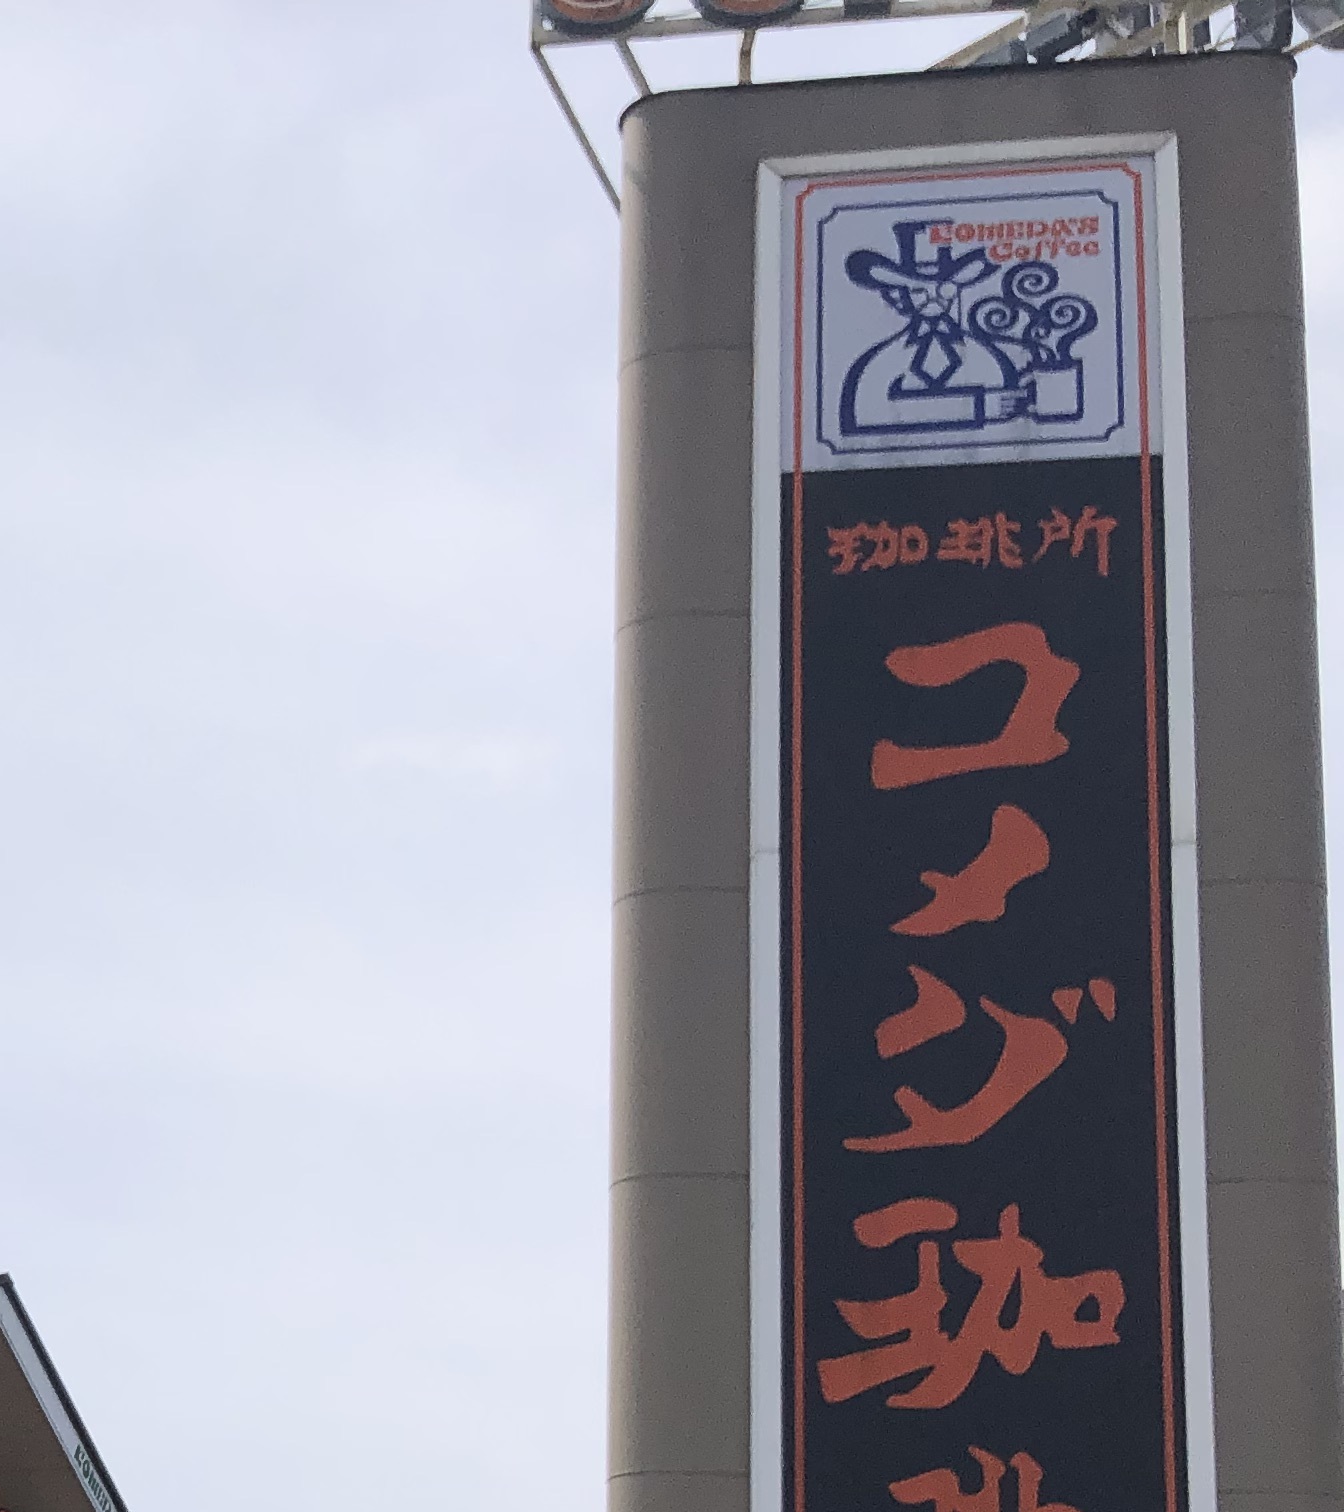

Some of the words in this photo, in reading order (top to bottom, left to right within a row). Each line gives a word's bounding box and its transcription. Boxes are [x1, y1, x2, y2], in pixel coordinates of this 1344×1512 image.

[929, 215, 1100, 246] KOMEDA'S
[987, 236, 1102, 263] Coffee
[825, 505, 1118, 577] 珈琲所
